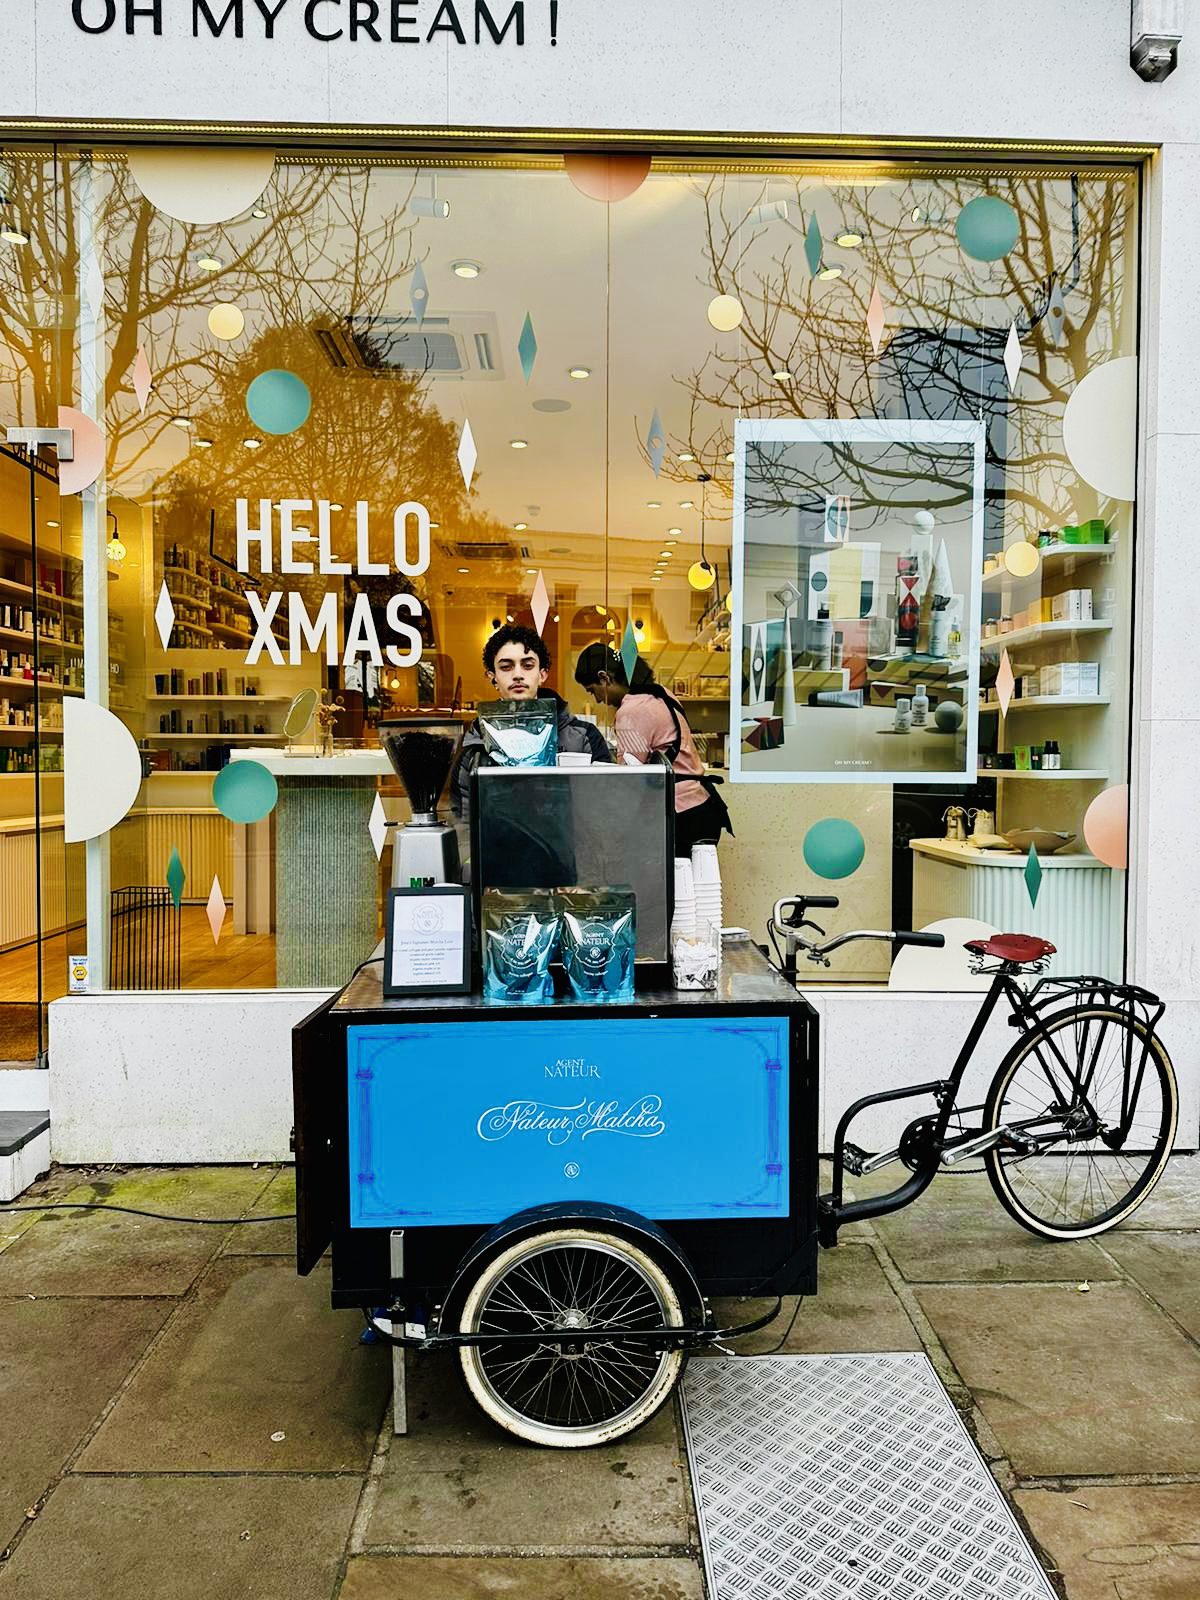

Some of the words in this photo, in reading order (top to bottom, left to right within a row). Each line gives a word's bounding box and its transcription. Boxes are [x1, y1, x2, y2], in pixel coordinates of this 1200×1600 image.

[71, 0, 163, 36] OH
[192, 0, 289, 39] MY
[235, 498, 432, 577] HELLO
[244, 590, 424, 669] XMAS
[579, 937, 611, 947] NATEUR
[543, 1064, 601, 1079] NATEUR
[555, 1058, 585, 1067] AGENT
[477, 1097, 587, 1146] Nateur
[574, 1094, 666, 1141] Matcha
